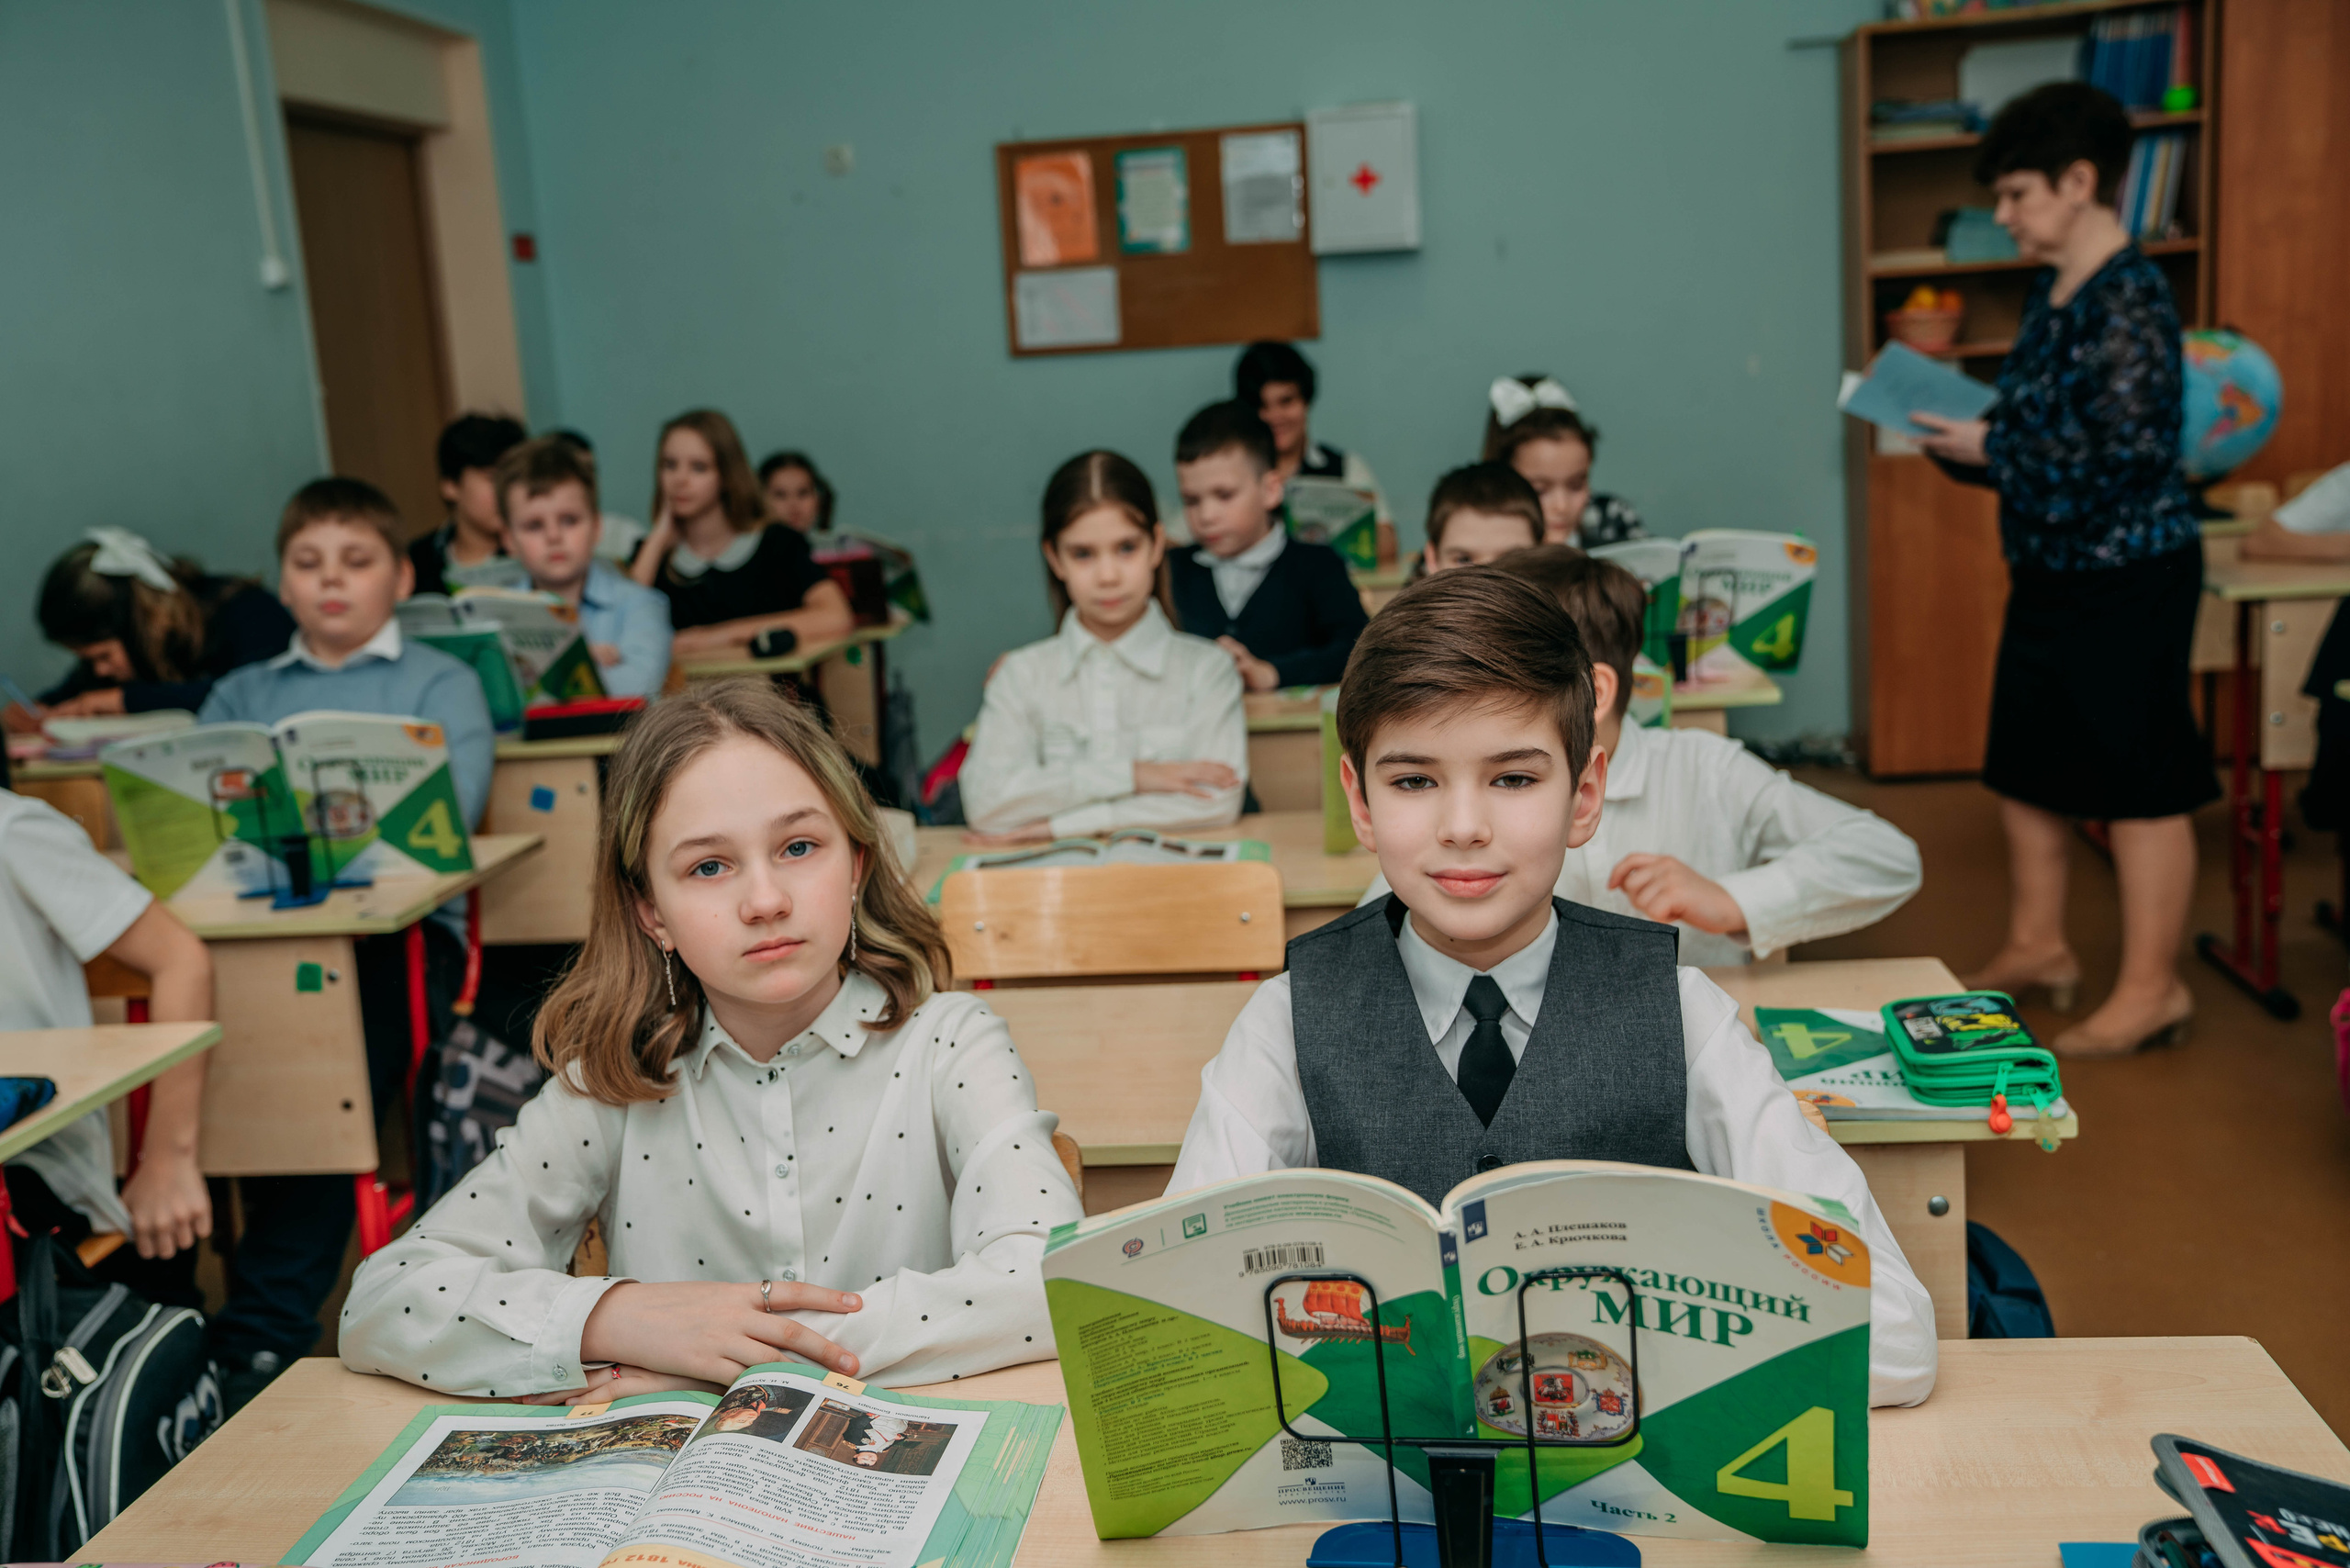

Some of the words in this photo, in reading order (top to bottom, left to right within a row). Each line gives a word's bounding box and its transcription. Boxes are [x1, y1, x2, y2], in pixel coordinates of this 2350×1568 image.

[408, 798, 463, 859] 4
[1772, 1023, 1852, 1059] 4
[1514, 1231, 1527, 1239] А.
[1530, 1227, 1543, 1236] А.
[1549, 1222, 1627, 1233] Плешаков
[1756, 1207, 1779, 1249] ШКОЛА
[1515, 1242, 1527, 1250] Е.
[1530, 1238, 1543, 1247] А.
[1549, 1233, 1627, 1245] Крючкова
[1783, 1253, 1841, 1291] РОССИИ
[1451, 1294, 1465, 1343] Окружающий
[1590, 1290, 1753, 1348] МИР
[1456, 1344, 1466, 1360] мир
[835, 1382, 849, 1390] 76
[857, 1402, 890, 1415] Бонапарт
[895, 1412, 930, 1420] Наполеон
[714, 1450, 743, 1459] армия
[758, 1448, 789, 1461] натиск
[725, 1462, 748, 1470] один
[749, 1456, 806, 1477] французская
[777, 1459, 794, 1469] был
[794, 1459, 834, 1476] сдержать
[804, 1457, 859, 1476] отступление.
[1717, 1406, 1853, 1521] 4
[697, 1464, 755, 1477] подчинилось
[752, 1468, 791, 1484] осталась
[800, 1466, 849, 1485] французов
[706, 1475, 755, 1490] Сражаться
[722, 1472, 759, 1485] Ушакову.
[759, 1476, 777, 1484] ему
[812, 1476, 833, 1486] года
[840, 1474, 871, 1484] смогли
[864, 1474, 895, 1483] начали
[699, 1478, 753, 1495] полководец
[781, 1484, 813, 1497] Вскоре
[796, 1483, 827, 1496] Россия
[839, 1484, 859, 1494] 1812
[856, 1483, 878, 1492] Удар
[887, 1487, 923, 1495] Россию.
[1278, 1485, 1345, 1494] ПРОСВЕЩЕНИЕ
[626, 1494, 646, 1502] шек.
[724, 1489, 744, 1497] шли
[834, 1488, 893, 1503] противником.
[538, 1499, 568, 1507] высоту
[603, 1496, 643, 1506] скольких
[749, 1496, 769, 1506] века
[757, 1494, 792, 1507] пришёл
[761, 1488, 823, 1511] императором.
[820, 1495, 840, 1505] мир.
[834, 1494, 868, 1505] Европы.
[1279, 1496, 1346, 1506] www.prosv.ru
[498, 1506, 551, 1517] Николаевич
[602, 1502, 639, 1512] генерал
[728, 1500, 789, 1524] НАПОЛЕОНА
[773, 1505, 792, 1515] XVIII
[797, 1506, 828, 1518] власти
[834, 1506, 892, 1518] приходилось
[871, 1506, 913, 1514] покорить
[1590, 1499, 1658, 1521] Часть
[1664, 1511, 1677, 1523] 2
[799, 1513, 824, 1523] конца
[828, 1510, 849, 1518] стал
[494, 1521, 534, 1530] началось
[595, 1517, 629, 1527] ворили
[661, 1523, 703, 1532] значение
[720, 1516, 764, 1533] гордимся
[445, 1524, 490, 1533] моментов
[512, 1524, 550, 1533] шестого
[667, 1529, 694, 1537] война
[793, 1521, 856, 1540] НАШЕСТВИЕ
[841, 1524, 874, 1534] Европе
[405, 1535, 465, 1544] Бородинском
[572, 1531, 618, 1542] Бородина,
[646, 1534, 714, 1549] иностранными
[700, 1535, 733, 1549] почему
[474, 1542, 515, 1551] широком
[596, 1540, 614, 1548] Оно
[789, 1539, 822, 1551] почему
[401, 1551, 455, 1560] просторном
[470, 1546, 520, 1556] подготовку
[771, 1545, 805, 1559] России.
[831, 1549, 874, 1560] Вспомни,
[849, 1546, 892, 1554] жарским.
[385, 1554, 453, 1565] решительному
[443, 1555, 520, 1568] БОРОДИНСКАЯ
[625, 1554, 668, 1562] 1812
[733, 1551, 766, 1566] России
[741, 1548, 788, 1566] Осознаем,
[811, 1557, 850, 1568] истории
